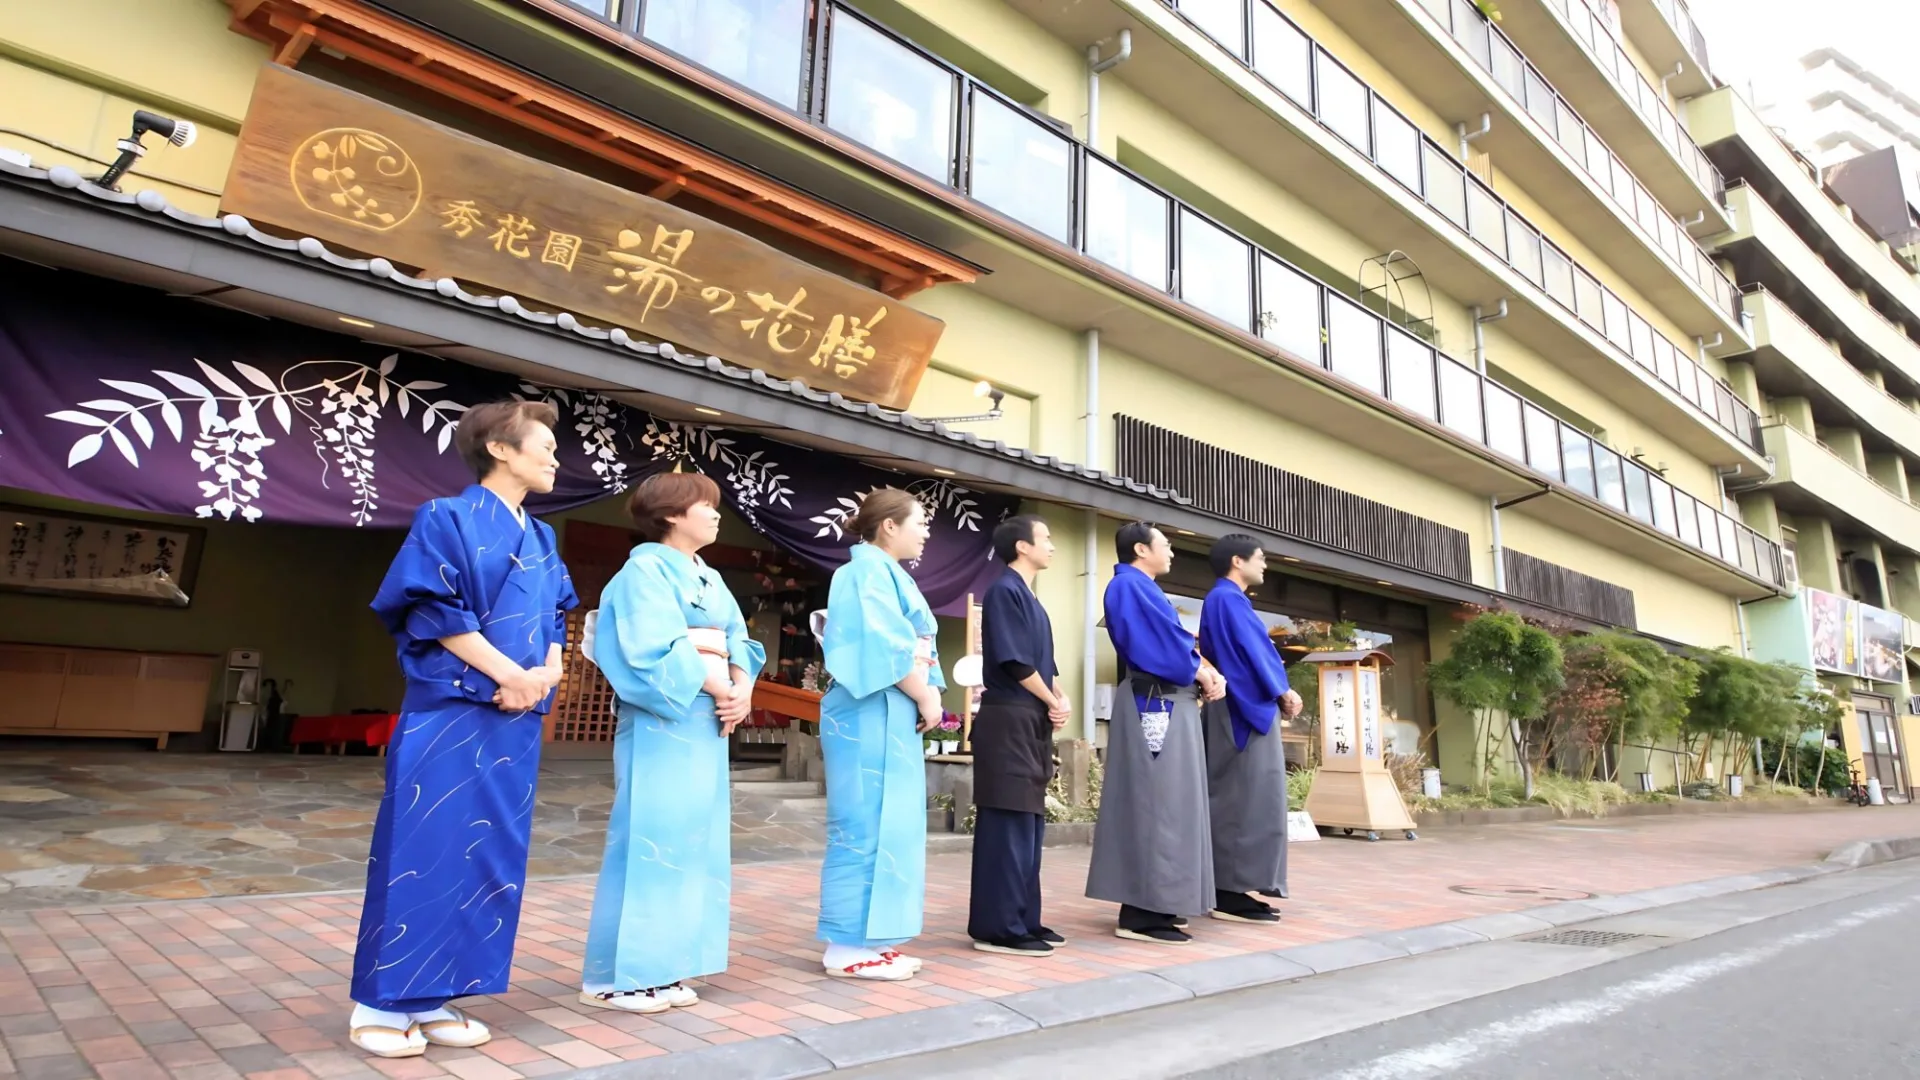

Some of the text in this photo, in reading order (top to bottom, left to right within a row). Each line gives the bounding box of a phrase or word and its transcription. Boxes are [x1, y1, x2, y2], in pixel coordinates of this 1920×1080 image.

[439, 200, 888, 380] 秀花園 湯の花膳
